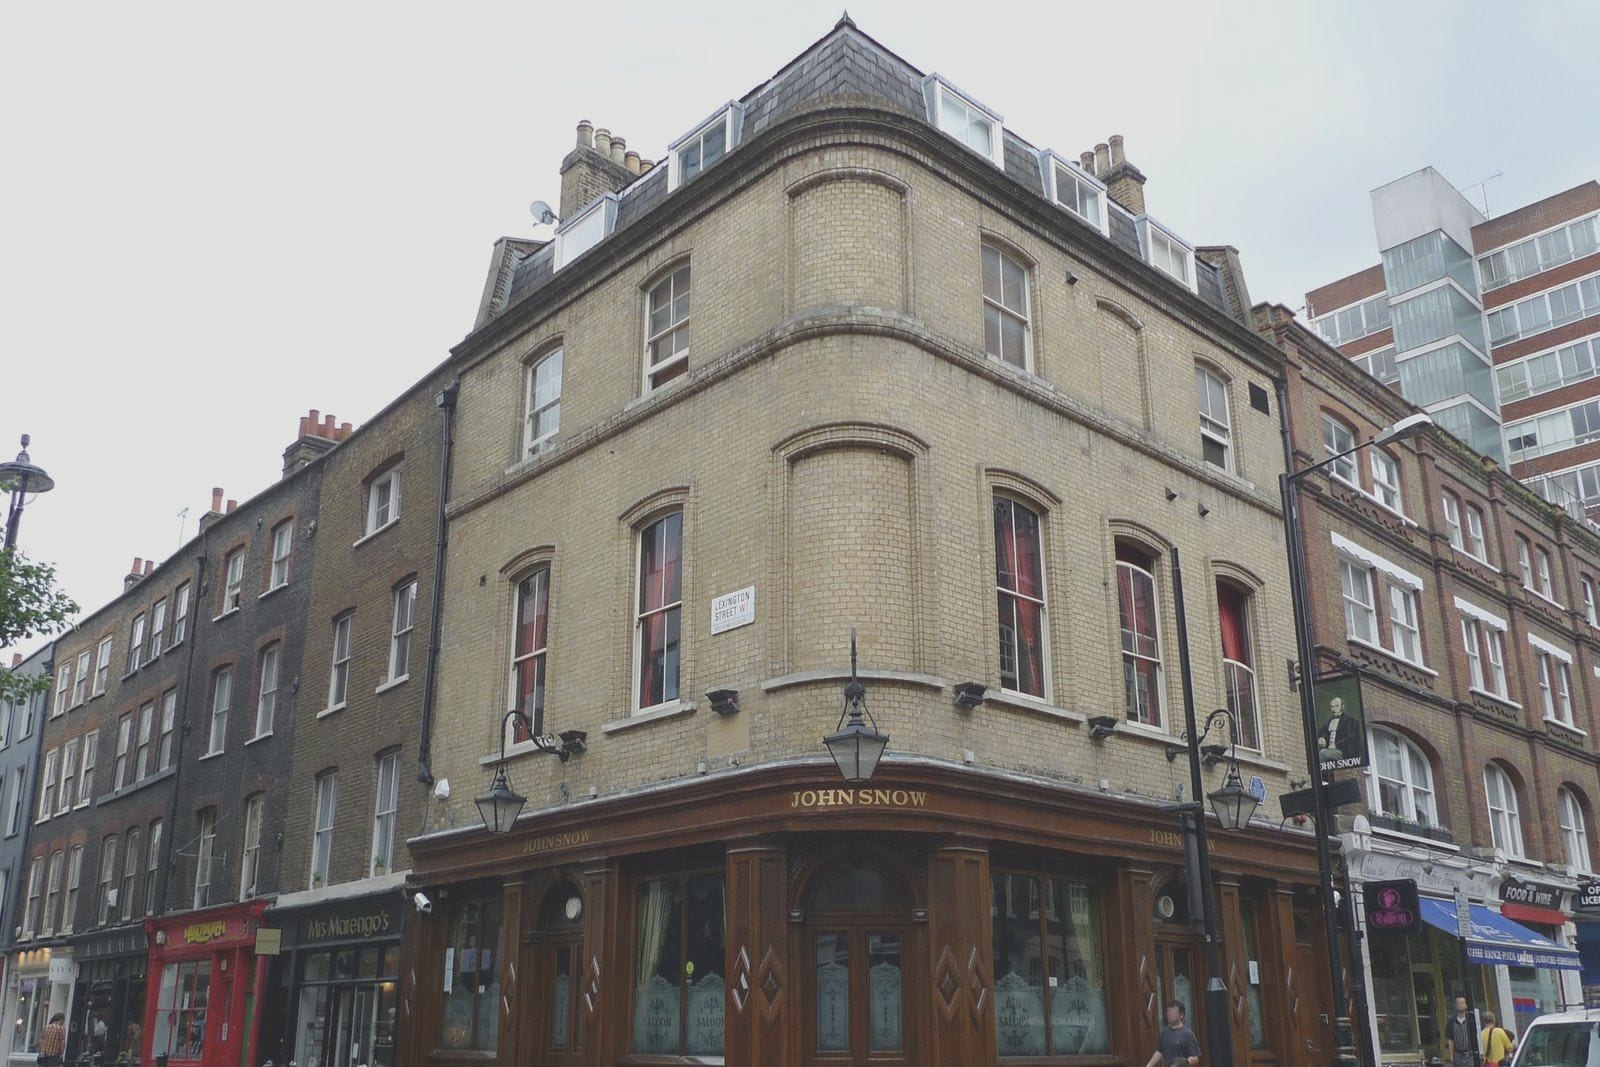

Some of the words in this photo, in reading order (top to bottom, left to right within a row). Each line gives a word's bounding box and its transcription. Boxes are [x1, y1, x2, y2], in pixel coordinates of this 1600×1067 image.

[715, 591, 750, 611] LEXINGTON
[715, 606, 737, 622] STREET
[1320, 762, 1336, 770] OHN
[1337, 757, 1361, 768] SNOW
[791, 789, 855, 808] JOHN
[858, 789, 927, 807] SNOW
[522, 836, 554, 853] JOHN
[556, 828, 591, 848] SNOW
[1149, 829, 1182, 846] JOHN
[1506, 887, 1528, 901] FOOD
[1535, 891, 1551, 905] WINE
[308, 919, 327, 938] Mrs
[328, 910, 389, 937] Marengo's
